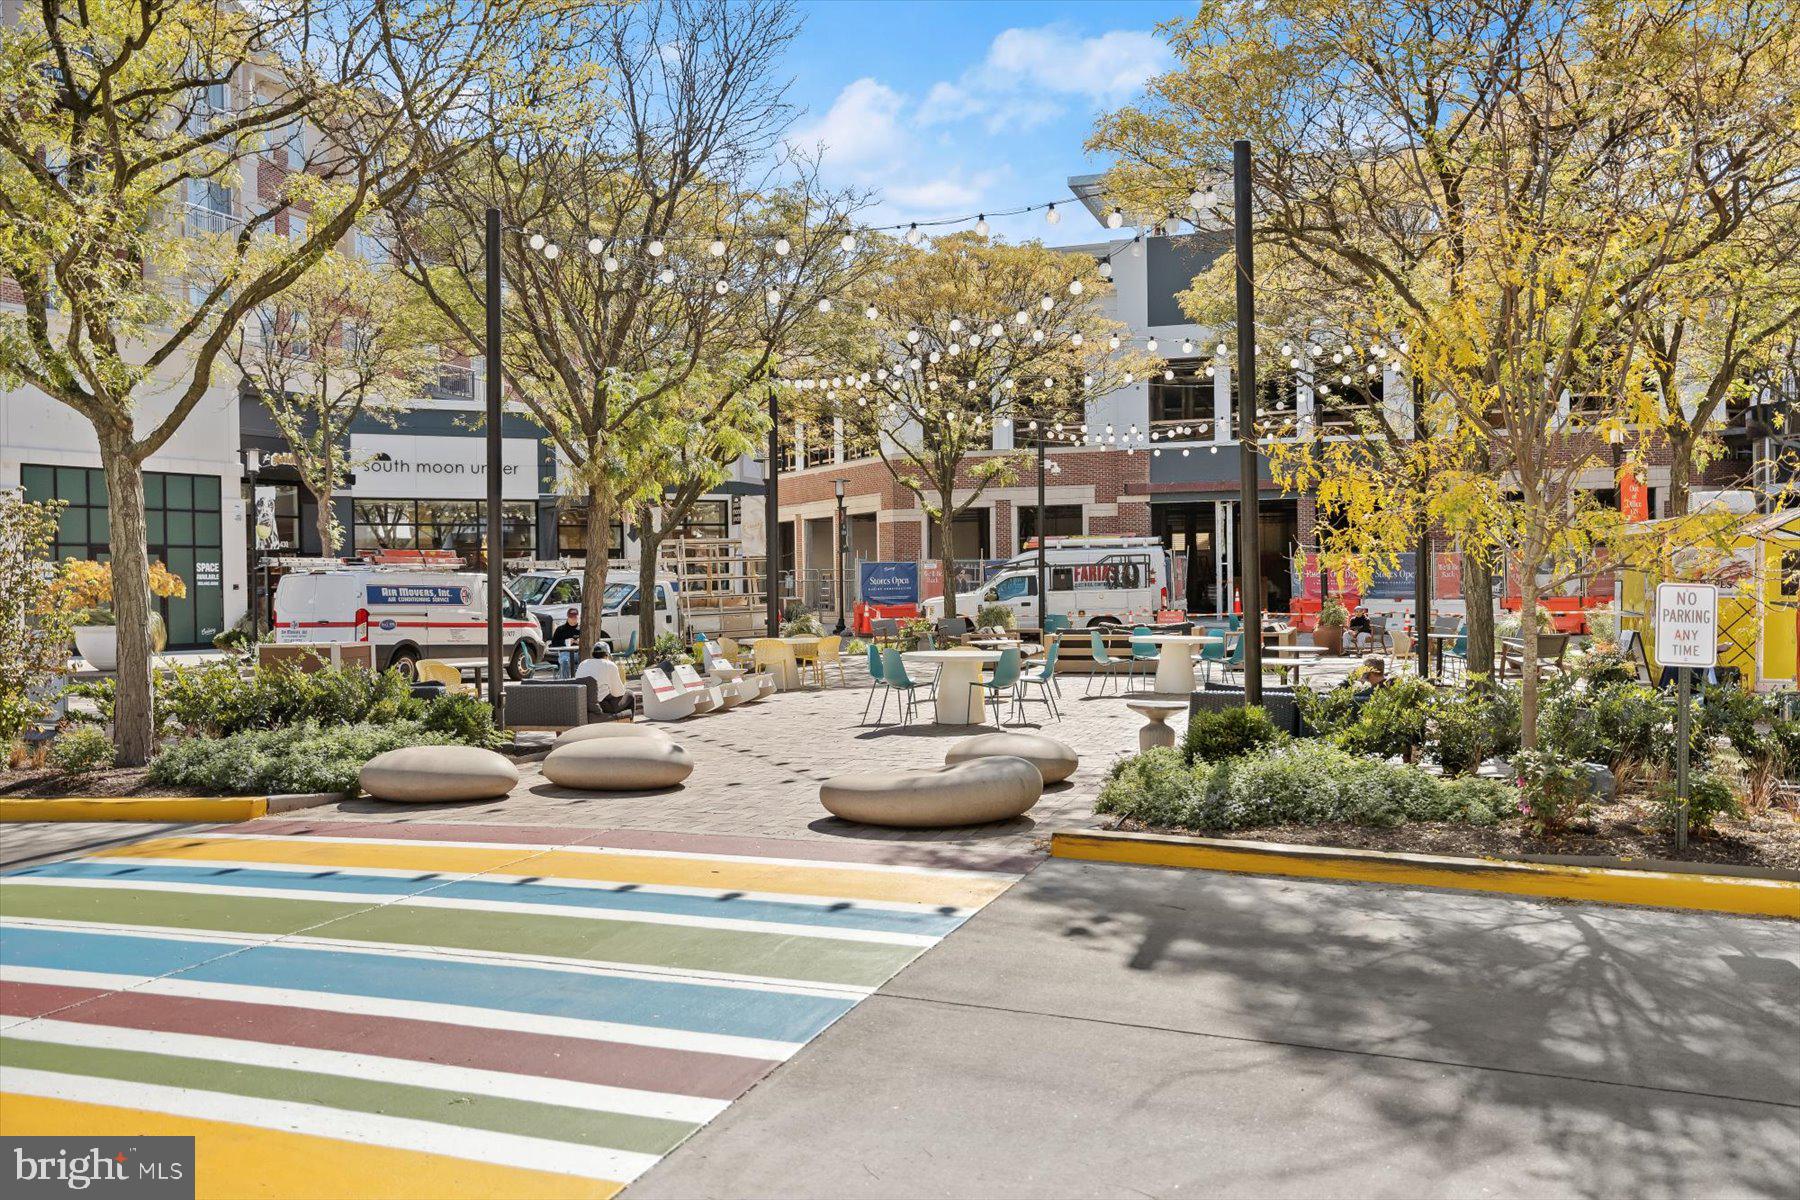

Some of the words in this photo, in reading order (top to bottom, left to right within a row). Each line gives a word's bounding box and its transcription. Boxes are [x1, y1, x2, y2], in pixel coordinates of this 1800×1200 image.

[363, 459, 410, 473] south
[416, 462, 465, 475] moon
[196, 562, 220, 573] SPACE
[869, 576, 891, 585] Stores
[891, 576, 910, 587] Open
[1676, 592, 1698, 606] NO
[1662, 608, 1711, 624] PARKING
[1674, 629, 1699, 641] ANY
[1672, 644, 1701, 657] TIME
